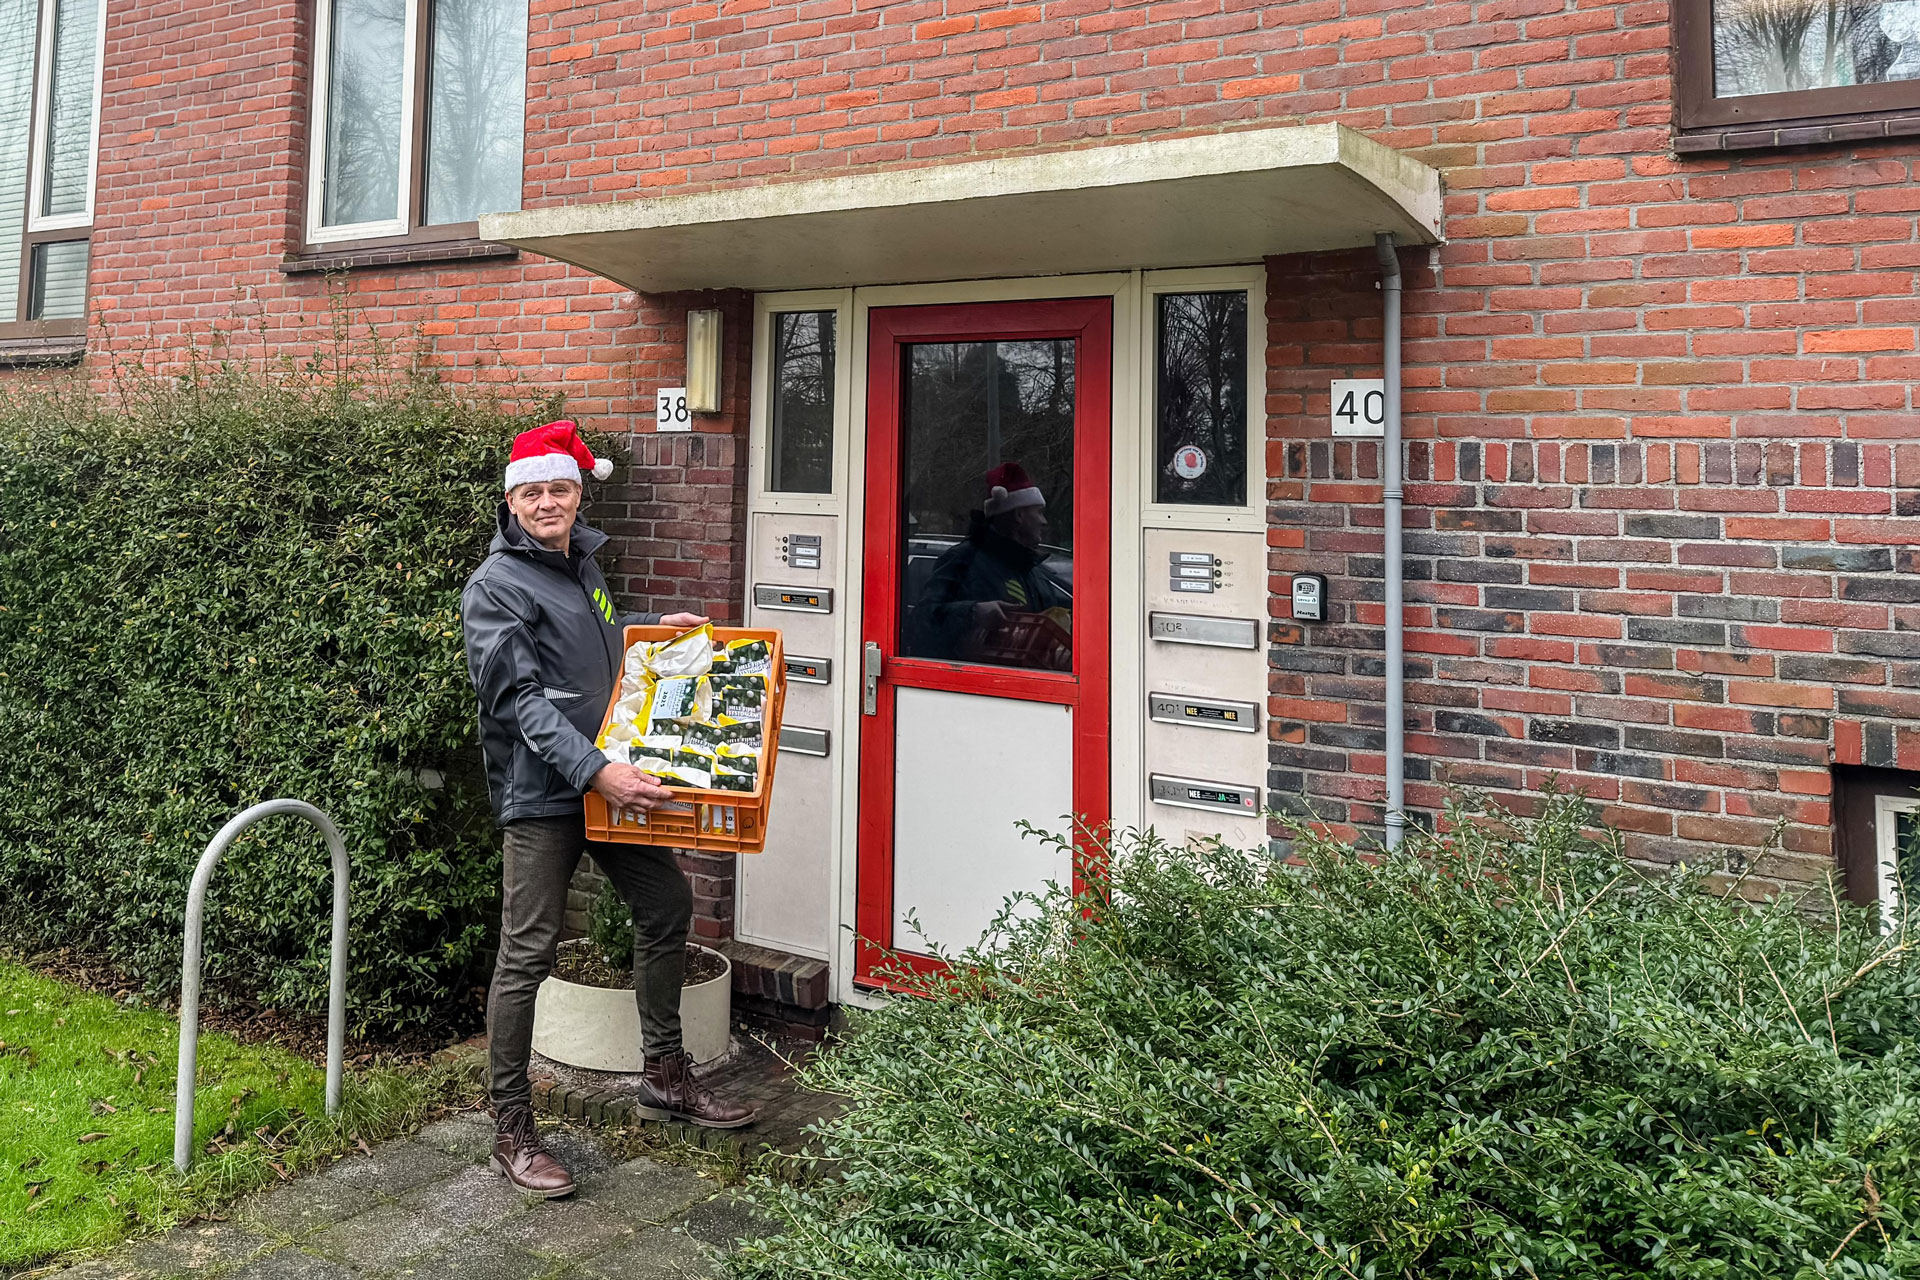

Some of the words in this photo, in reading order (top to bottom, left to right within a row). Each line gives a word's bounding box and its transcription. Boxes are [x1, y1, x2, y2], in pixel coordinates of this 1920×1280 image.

[660, 396, 688, 422] 38
[1335, 390, 1384, 424] 40
[1186, 707, 1198, 716] NEE
[1224, 711, 1237, 720] NEE
[1188, 789, 1201, 799] NEE
[1217, 793, 1227, 802] JA
